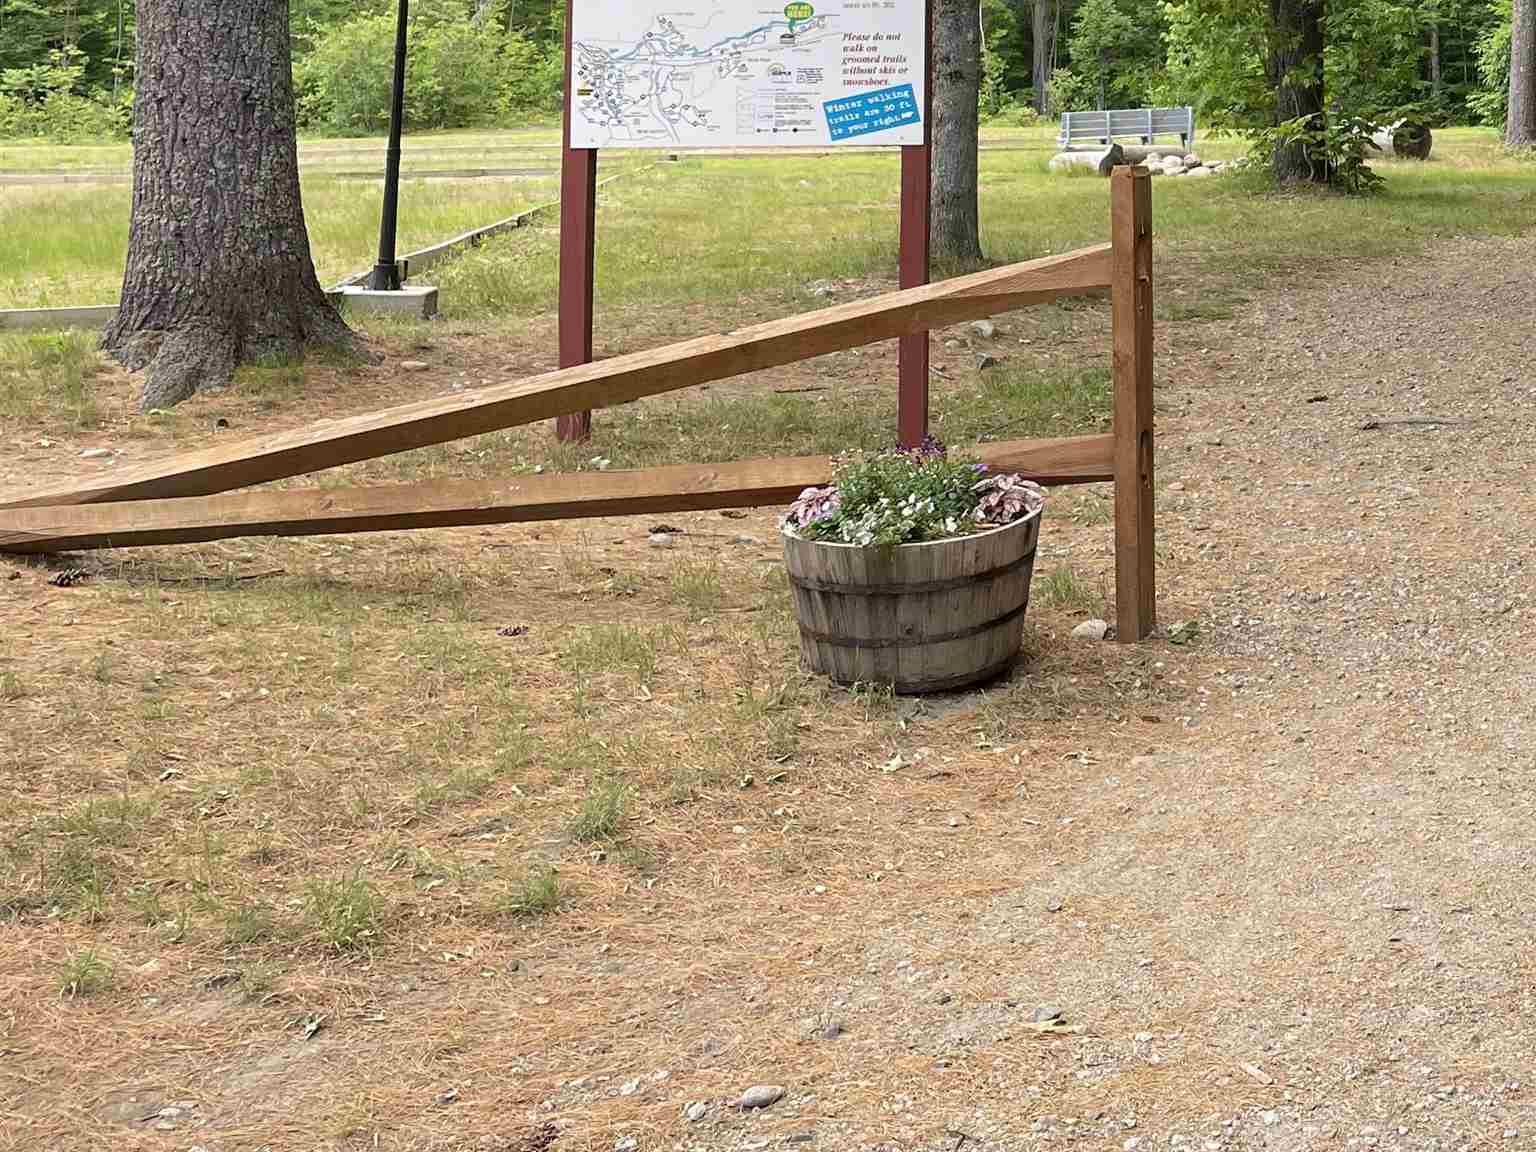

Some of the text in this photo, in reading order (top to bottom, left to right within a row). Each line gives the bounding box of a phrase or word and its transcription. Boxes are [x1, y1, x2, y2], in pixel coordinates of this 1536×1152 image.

[842, 32, 901, 42] Please do not
[842, 43, 878, 53] walk on
[841, 54, 907, 65] groomed trails
[842, 66, 909, 76] without skis or
[825, 90, 912, 113] Winter walking
[829, 112, 861, 125] trails
